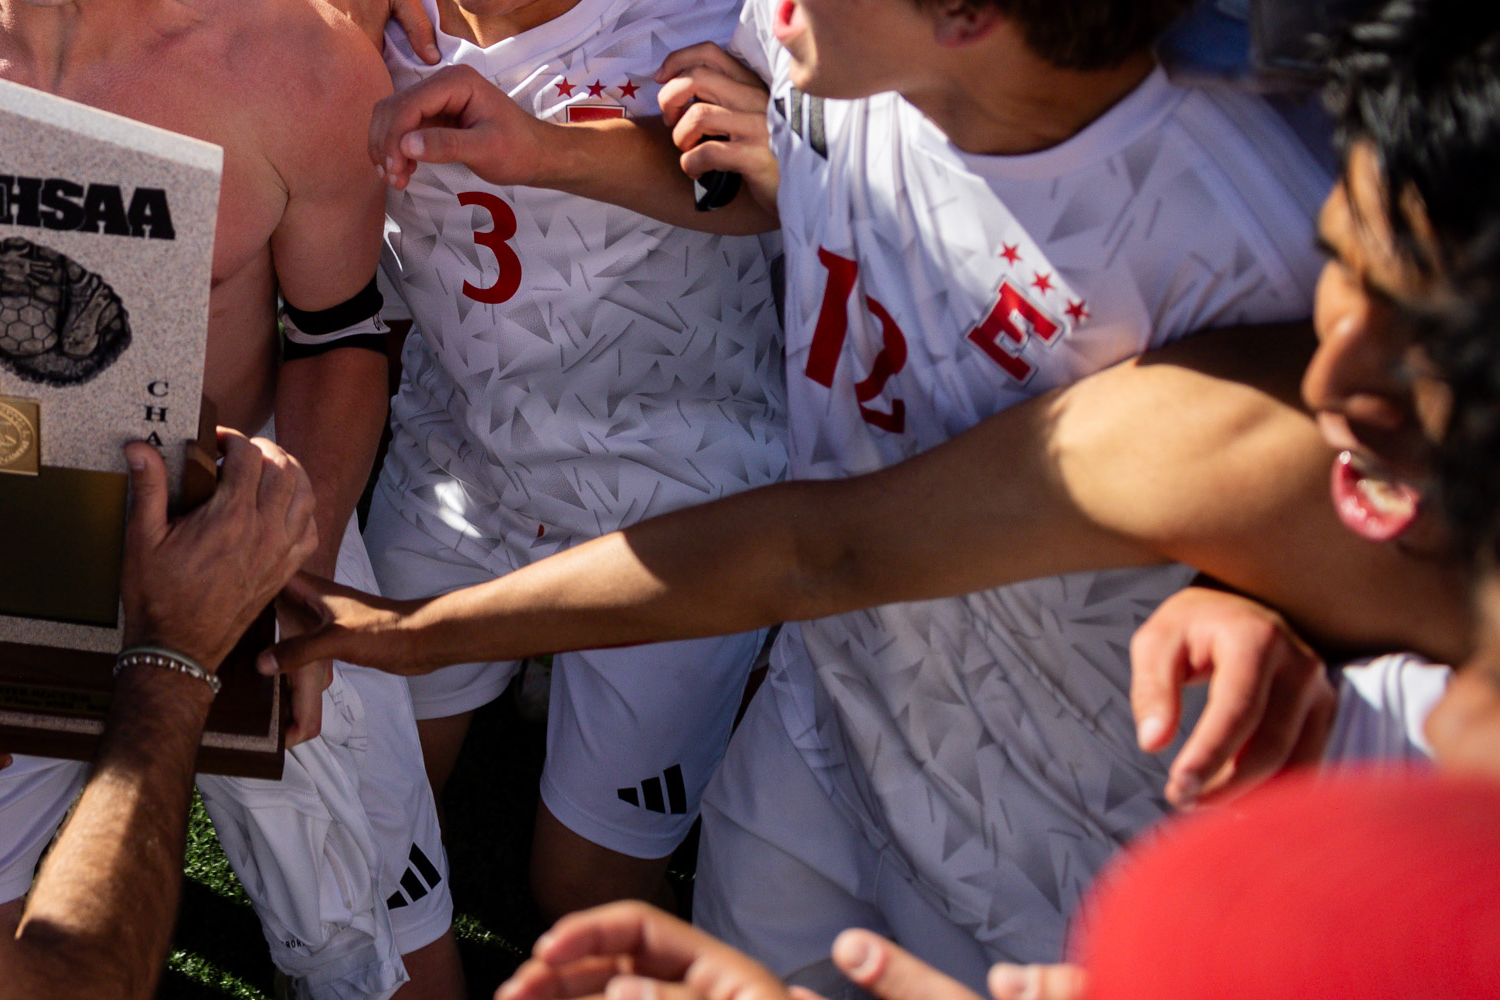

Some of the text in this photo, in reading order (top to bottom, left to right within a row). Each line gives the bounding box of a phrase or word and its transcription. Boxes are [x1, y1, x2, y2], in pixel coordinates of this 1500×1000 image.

[456, 191, 522, 305] 3
[805, 245, 908, 434] 12
[963, 274, 1067, 388] E
